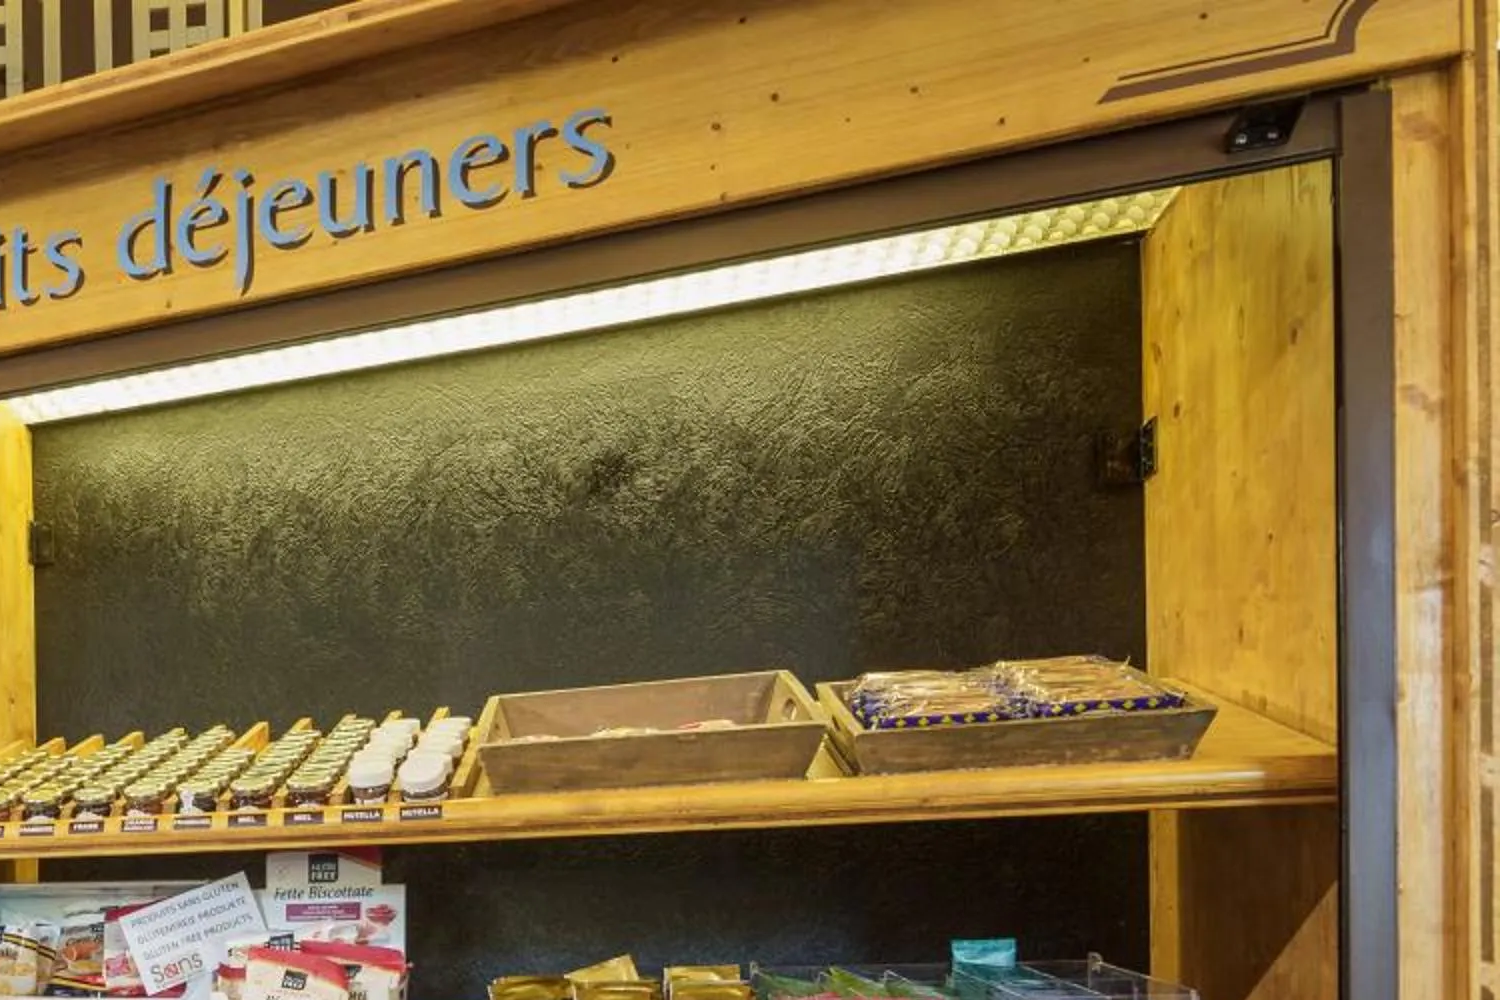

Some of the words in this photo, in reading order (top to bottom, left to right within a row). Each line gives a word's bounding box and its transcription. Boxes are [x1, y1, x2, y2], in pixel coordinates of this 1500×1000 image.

[117, 108, 615, 295] déjeuners
[343, 810, 380, 820] NUTELLA
[403, 806, 439, 817] NUTELLA
[177, 896, 202, 913] SANS
[203, 882, 240, 901] GLUTEN
[274, 887, 305, 901] Fette
[308, 885, 375, 899] Biscottate
